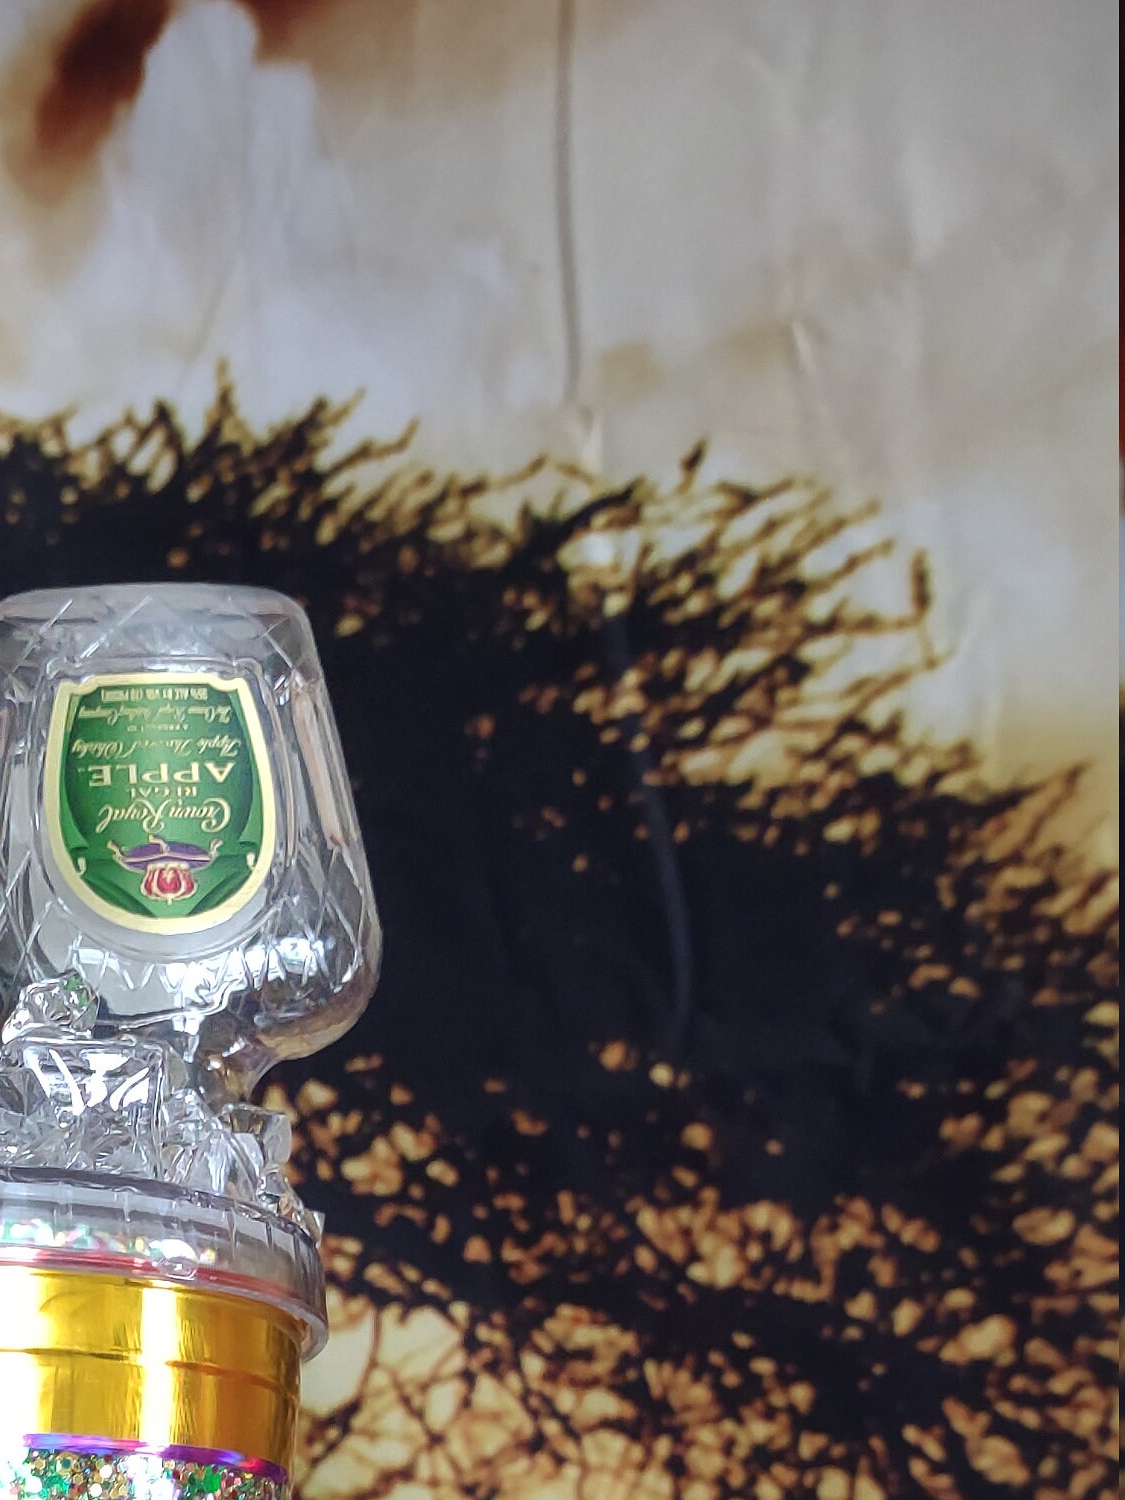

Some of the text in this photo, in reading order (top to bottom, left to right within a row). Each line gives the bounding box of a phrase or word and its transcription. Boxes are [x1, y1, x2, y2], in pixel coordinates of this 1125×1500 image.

[87, 760, 236, 787] APPLE
[96, 797, 232, 834] Crown Royal
